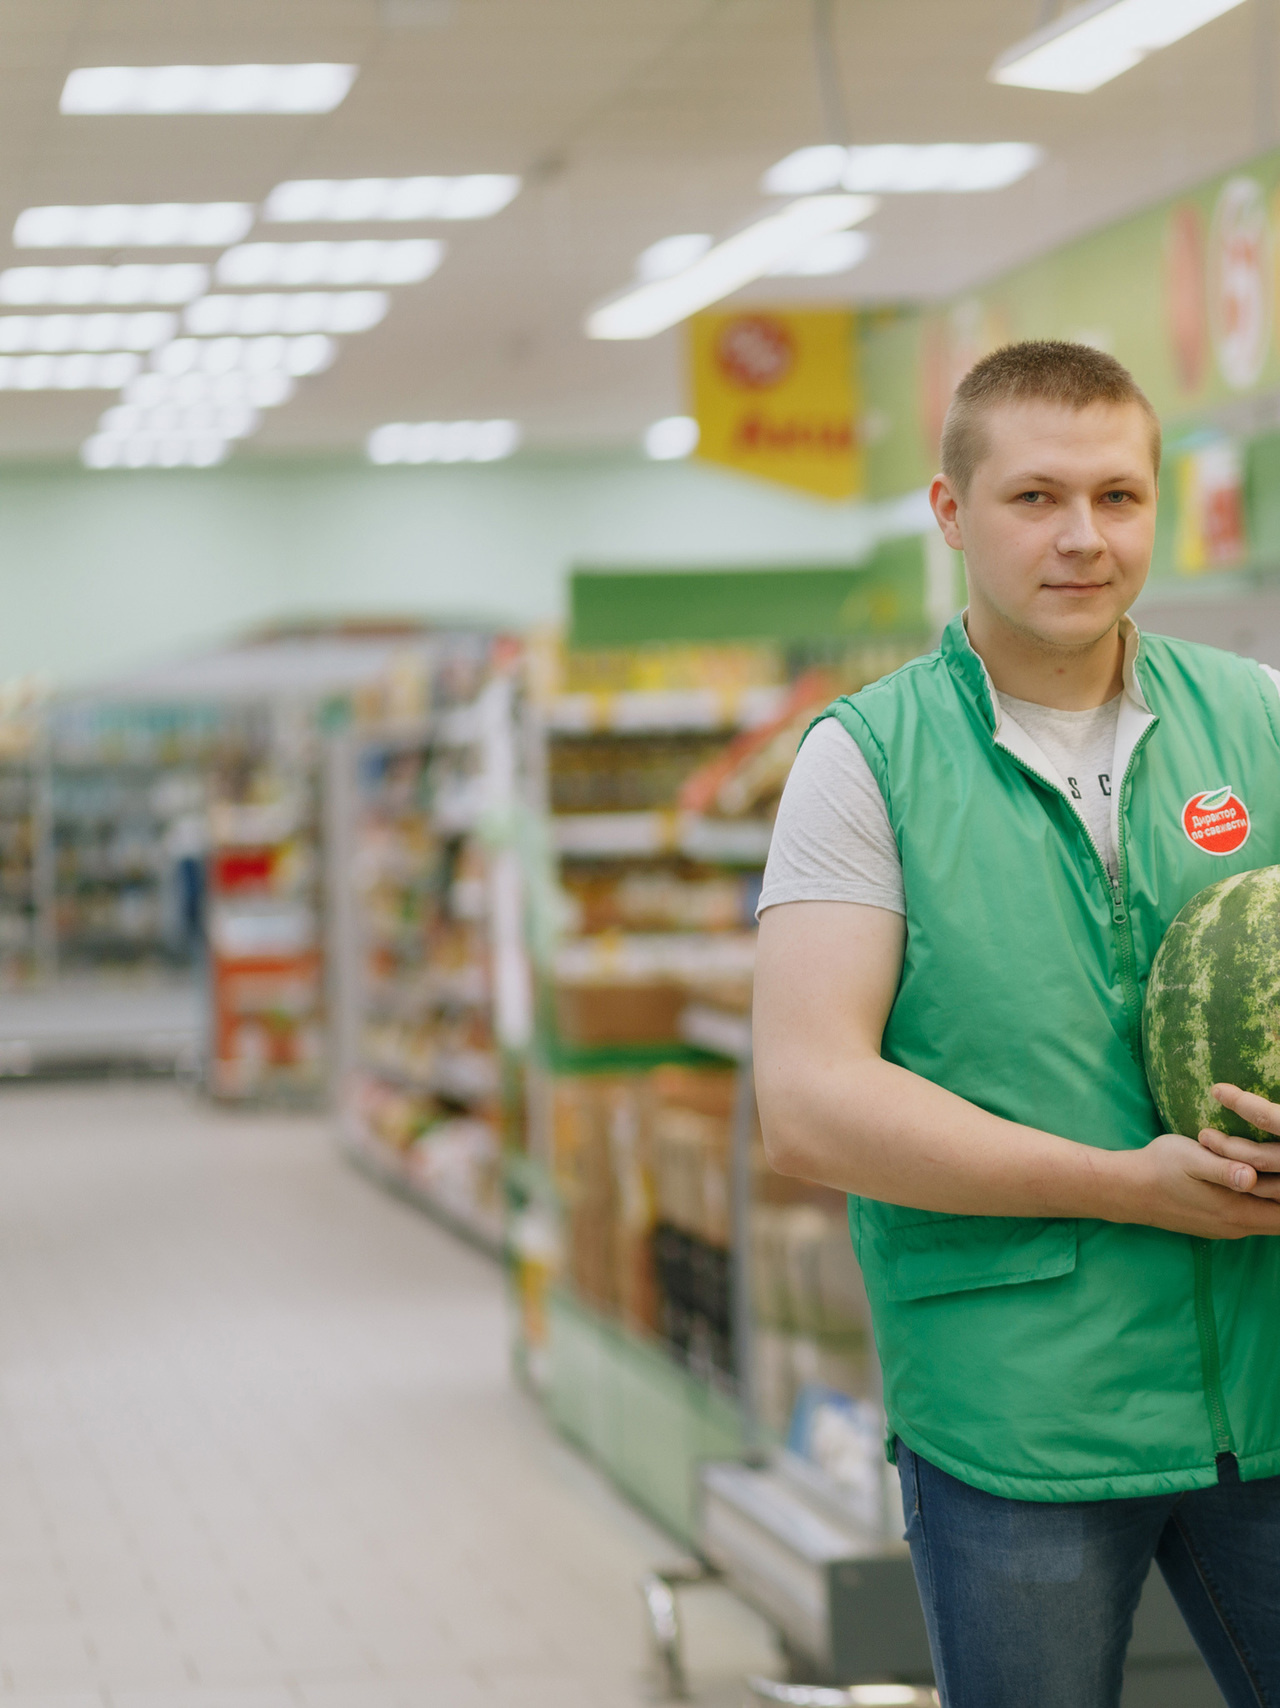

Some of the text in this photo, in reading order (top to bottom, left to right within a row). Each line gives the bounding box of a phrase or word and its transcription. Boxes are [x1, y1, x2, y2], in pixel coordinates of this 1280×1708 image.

[1191, 807, 1237, 829] Директор
[1191, 818, 1248, 840] по свежести
